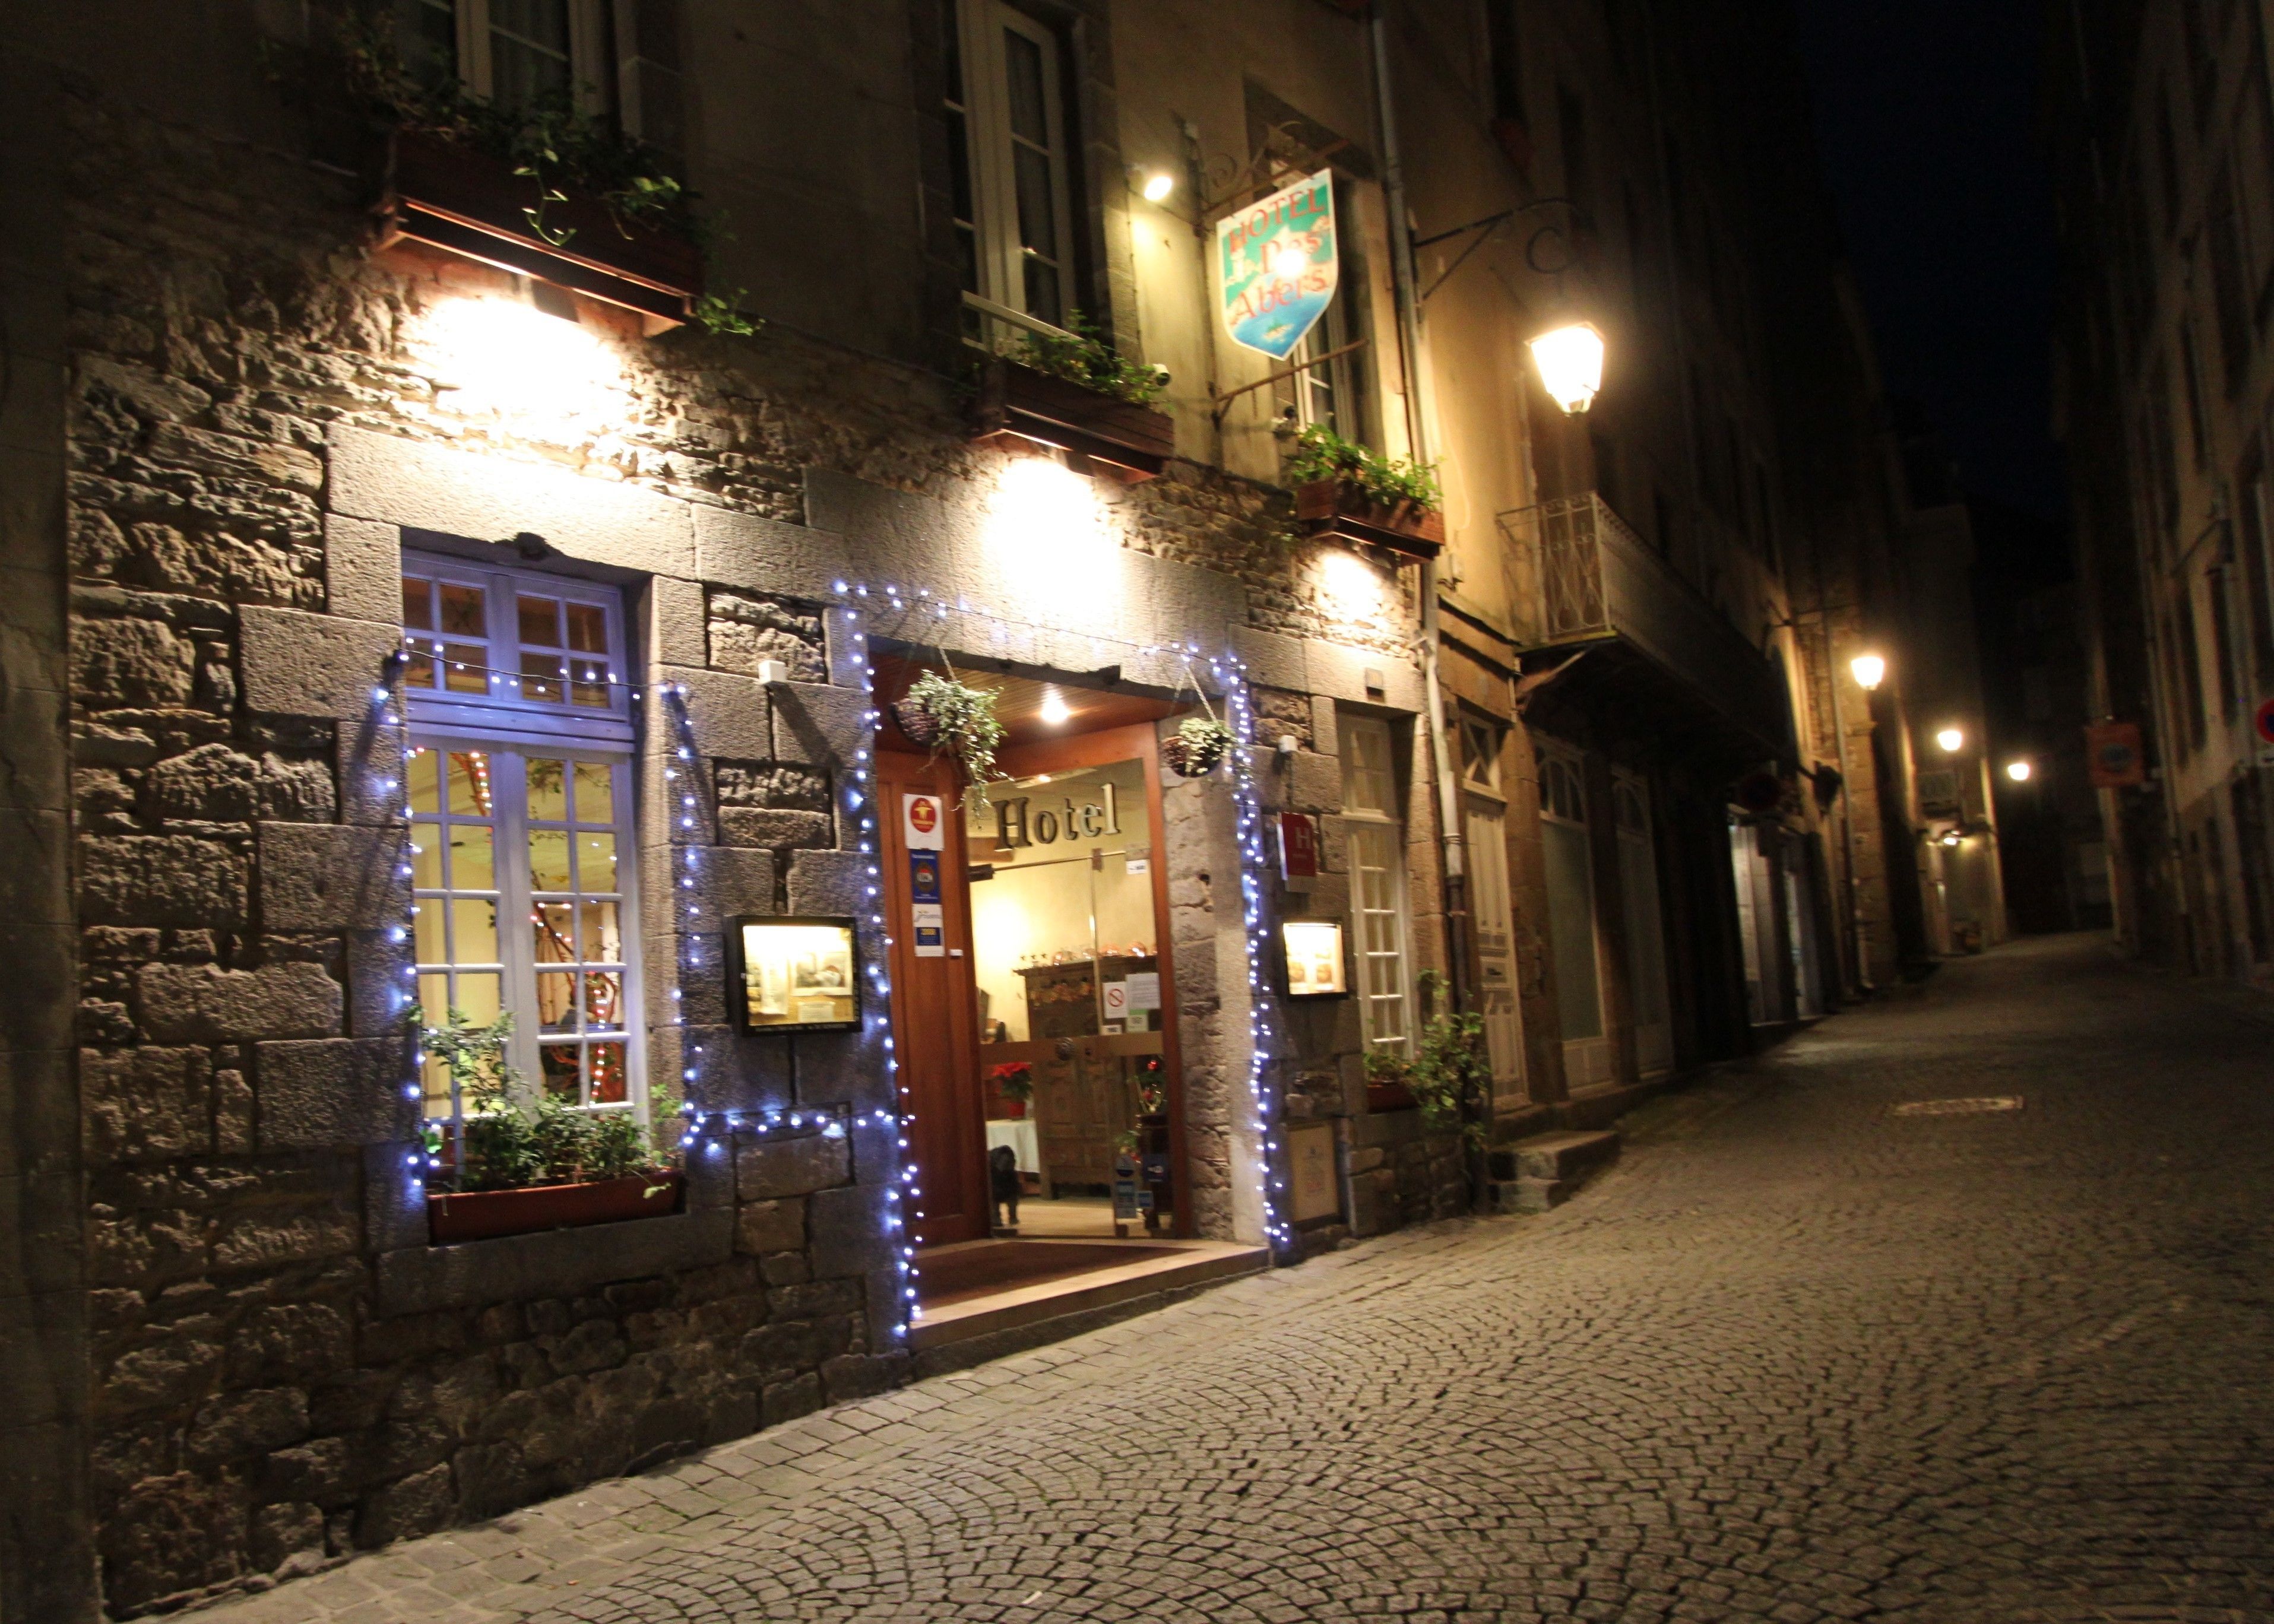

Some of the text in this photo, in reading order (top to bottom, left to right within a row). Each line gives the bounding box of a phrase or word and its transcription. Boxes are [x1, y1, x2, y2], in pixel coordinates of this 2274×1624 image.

[1228, 188, 1325, 253] HOTEL
[1231, 269, 1326, 326] Abers
[993, 783, 1121, 850] Hotel
